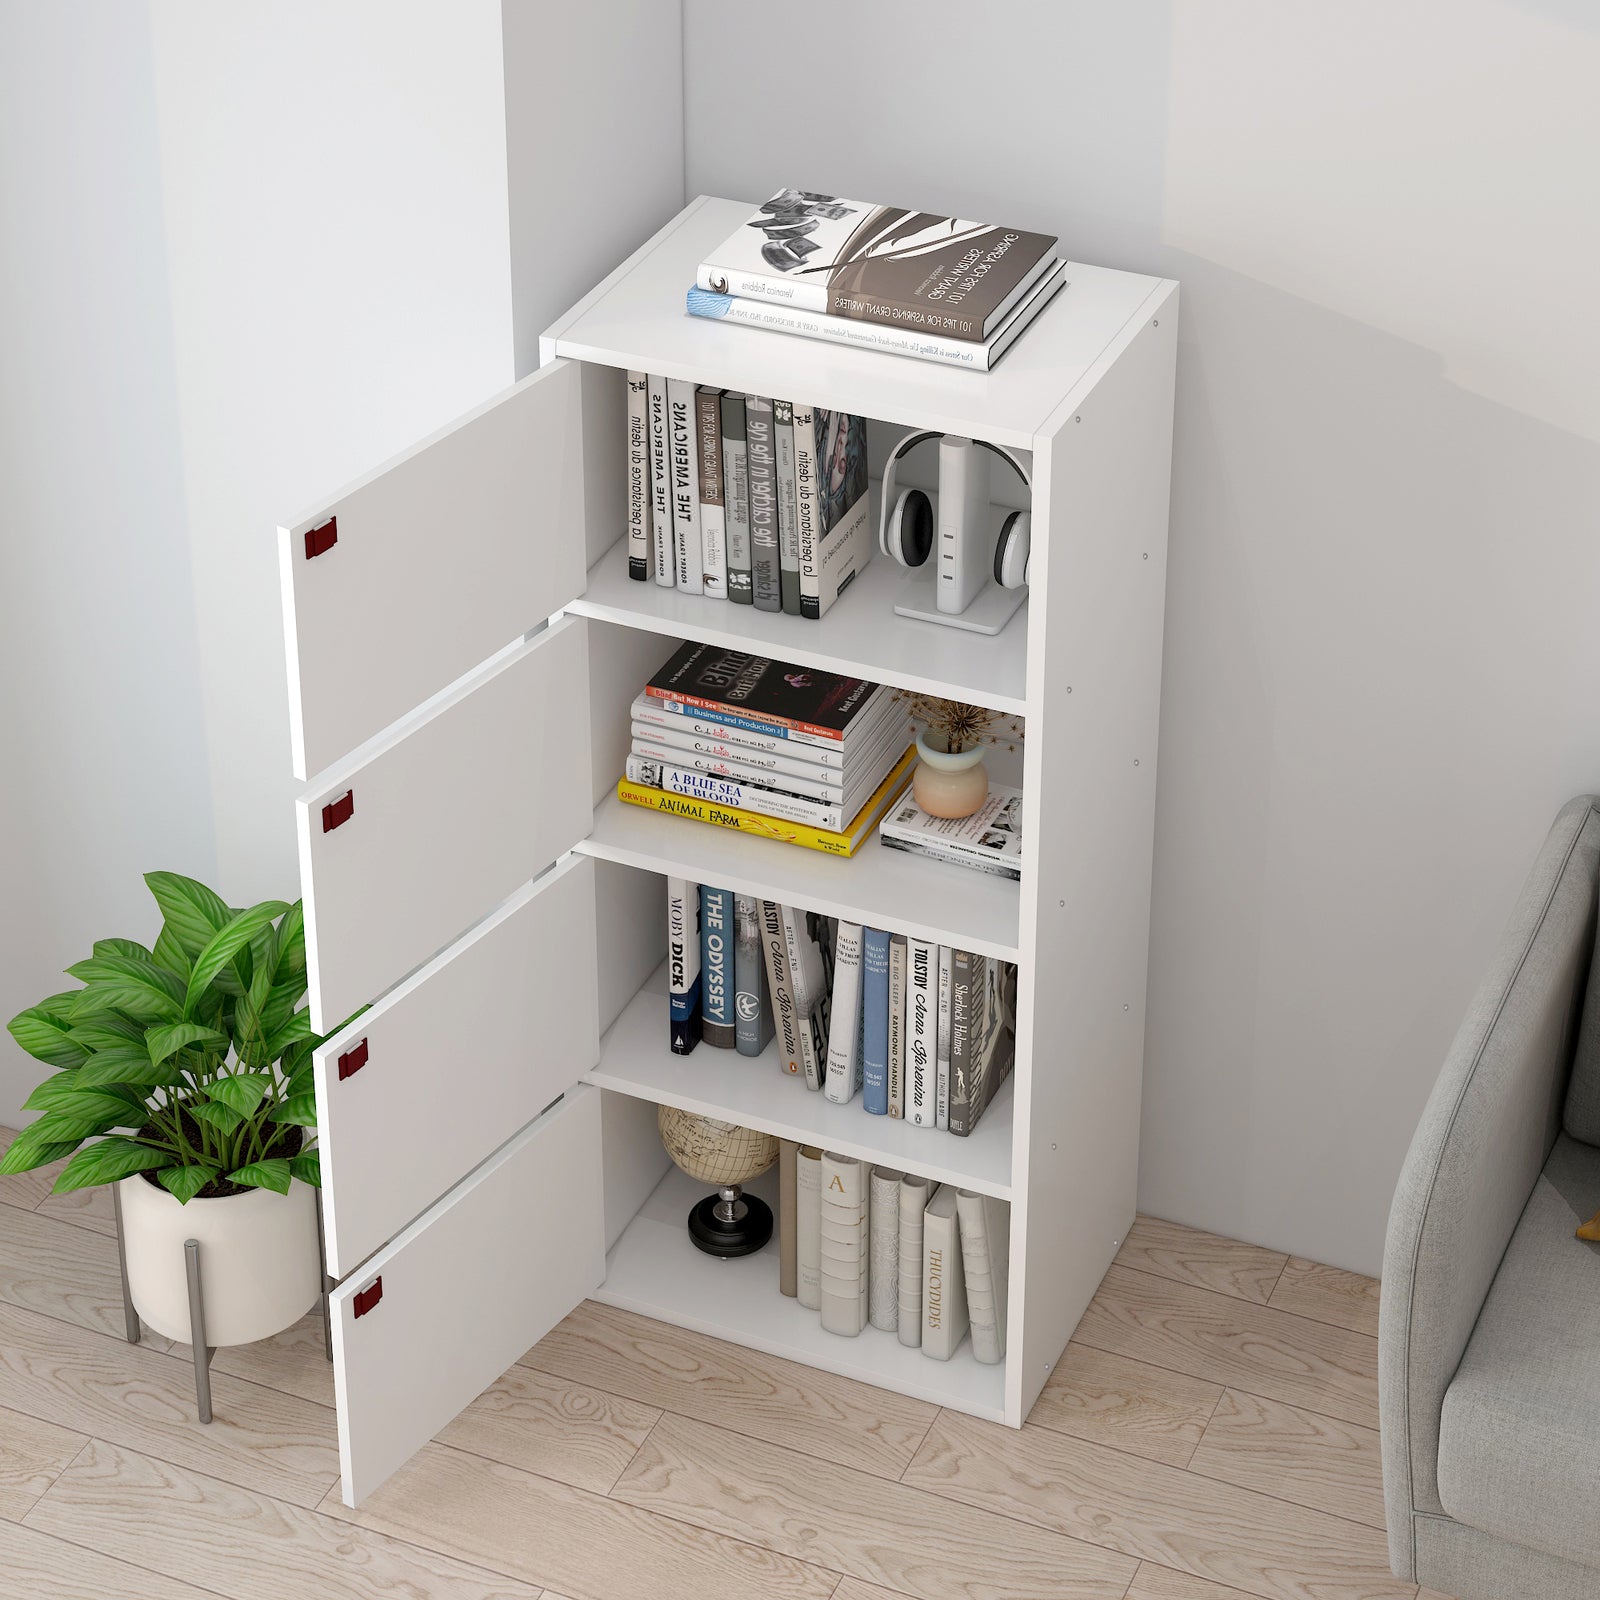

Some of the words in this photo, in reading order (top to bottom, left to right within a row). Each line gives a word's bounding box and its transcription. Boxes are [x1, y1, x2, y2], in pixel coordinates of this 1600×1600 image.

[701, 401, 715, 412] 101
[702, 412, 715, 424] TIPS
[703, 423, 716, 435] FOR
[703, 434, 717, 460] ASPIRING
[704, 459, 718, 478] GRANT
[705, 478, 719, 500] WRITERS
[655, 689, 672, 699] Blind
[673, 693, 685, 703] But
[686, 697, 700, 706] Now
[704, 701, 718, 710] See
[727, 679, 754, 700] But
[694, 708, 723, 721] Business
[723, 716, 737, 724] and
[738, 719, 776, 733] Production
[670, 771, 680, 783] A
[683, 774, 717, 791] BLUE
[718, 783, 743, 798] SEA
[673, 782, 691, 794] OF
[693, 788, 740, 806] BLOOD
[621, 791, 655, 806] ORWELL
[658, 797, 706, 819] ANIMAL
[709, 809, 741, 828] FARM
[670, 895, 684, 941] MOBY
[706, 894, 725, 930] THE
[762, 900, 780, 936] OLSTOY
[785, 925, 795, 945] AFTER
[790, 957, 798, 972] END
[892, 949, 900, 964] THE
[671, 941, 684, 988] DICK
[770, 940, 785, 984] Anna
[892, 966, 900, 980] BIG
[913, 948, 928, 990] TOLSTOY
[707, 934, 725, 1021] ODYSSEY
[941, 968, 949, 987] AFTER
[914, 993, 929, 1036] Anna
[940, 999, 948, 1013] END
[953, 982, 969, 1024] Sherlock
[774, 987, 797, 1056] Karenina
[800, 1032, 811, 1058] AUTHOR
[891, 1014, 899, 1056] RAYMOND
[953, 1022, 968, 1057] Holmes
[805, 1059, 814, 1078] NAME
[911, 1039, 928, 1109] Karenina
[939, 1073, 947, 1097] AUTHOR
[828, 1175, 846, 1193] A
[928, 1249, 942, 1331] THUCYDIDES
